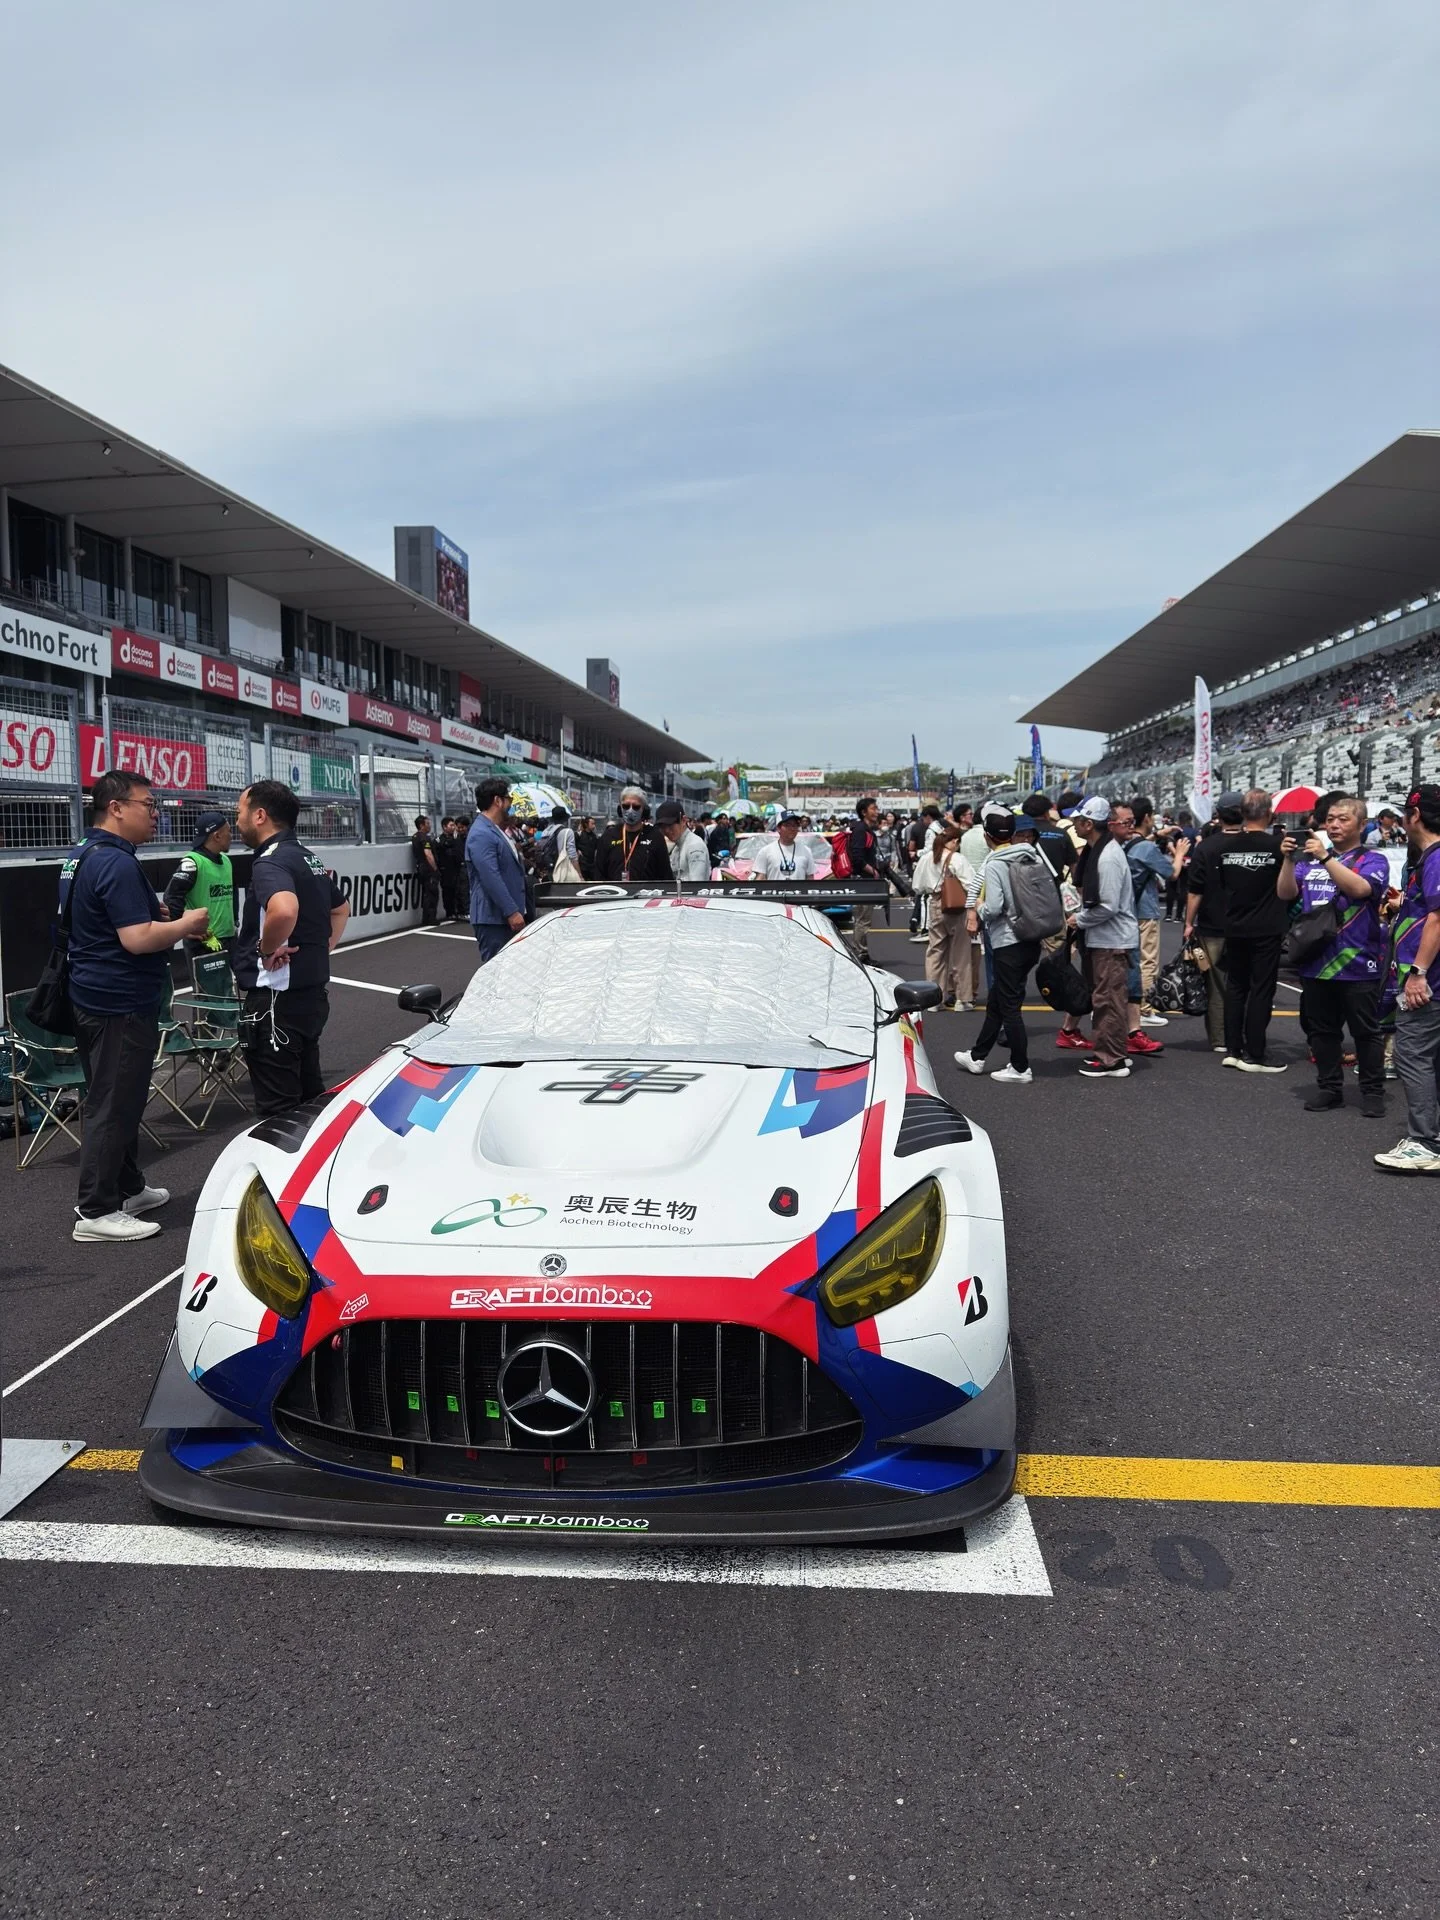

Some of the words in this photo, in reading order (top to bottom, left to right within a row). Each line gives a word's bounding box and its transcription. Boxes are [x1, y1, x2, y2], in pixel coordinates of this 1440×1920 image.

[131, 645, 153, 659] docomo
[322, 696, 341, 714] MUFG
[366, 701, 394, 727] Astemo
[407, 715, 431, 738] Astemo
[0, 720, 56, 772] SO
[328, 870, 424, 917] RIDGESTO
[563, 1195, 697, 1221] 奥辰生物
[560, 1216, 603, 1226] Aochen
[607, 1218, 693, 1235] Biotechnology
[345, 1297, 366, 1315] TOW
